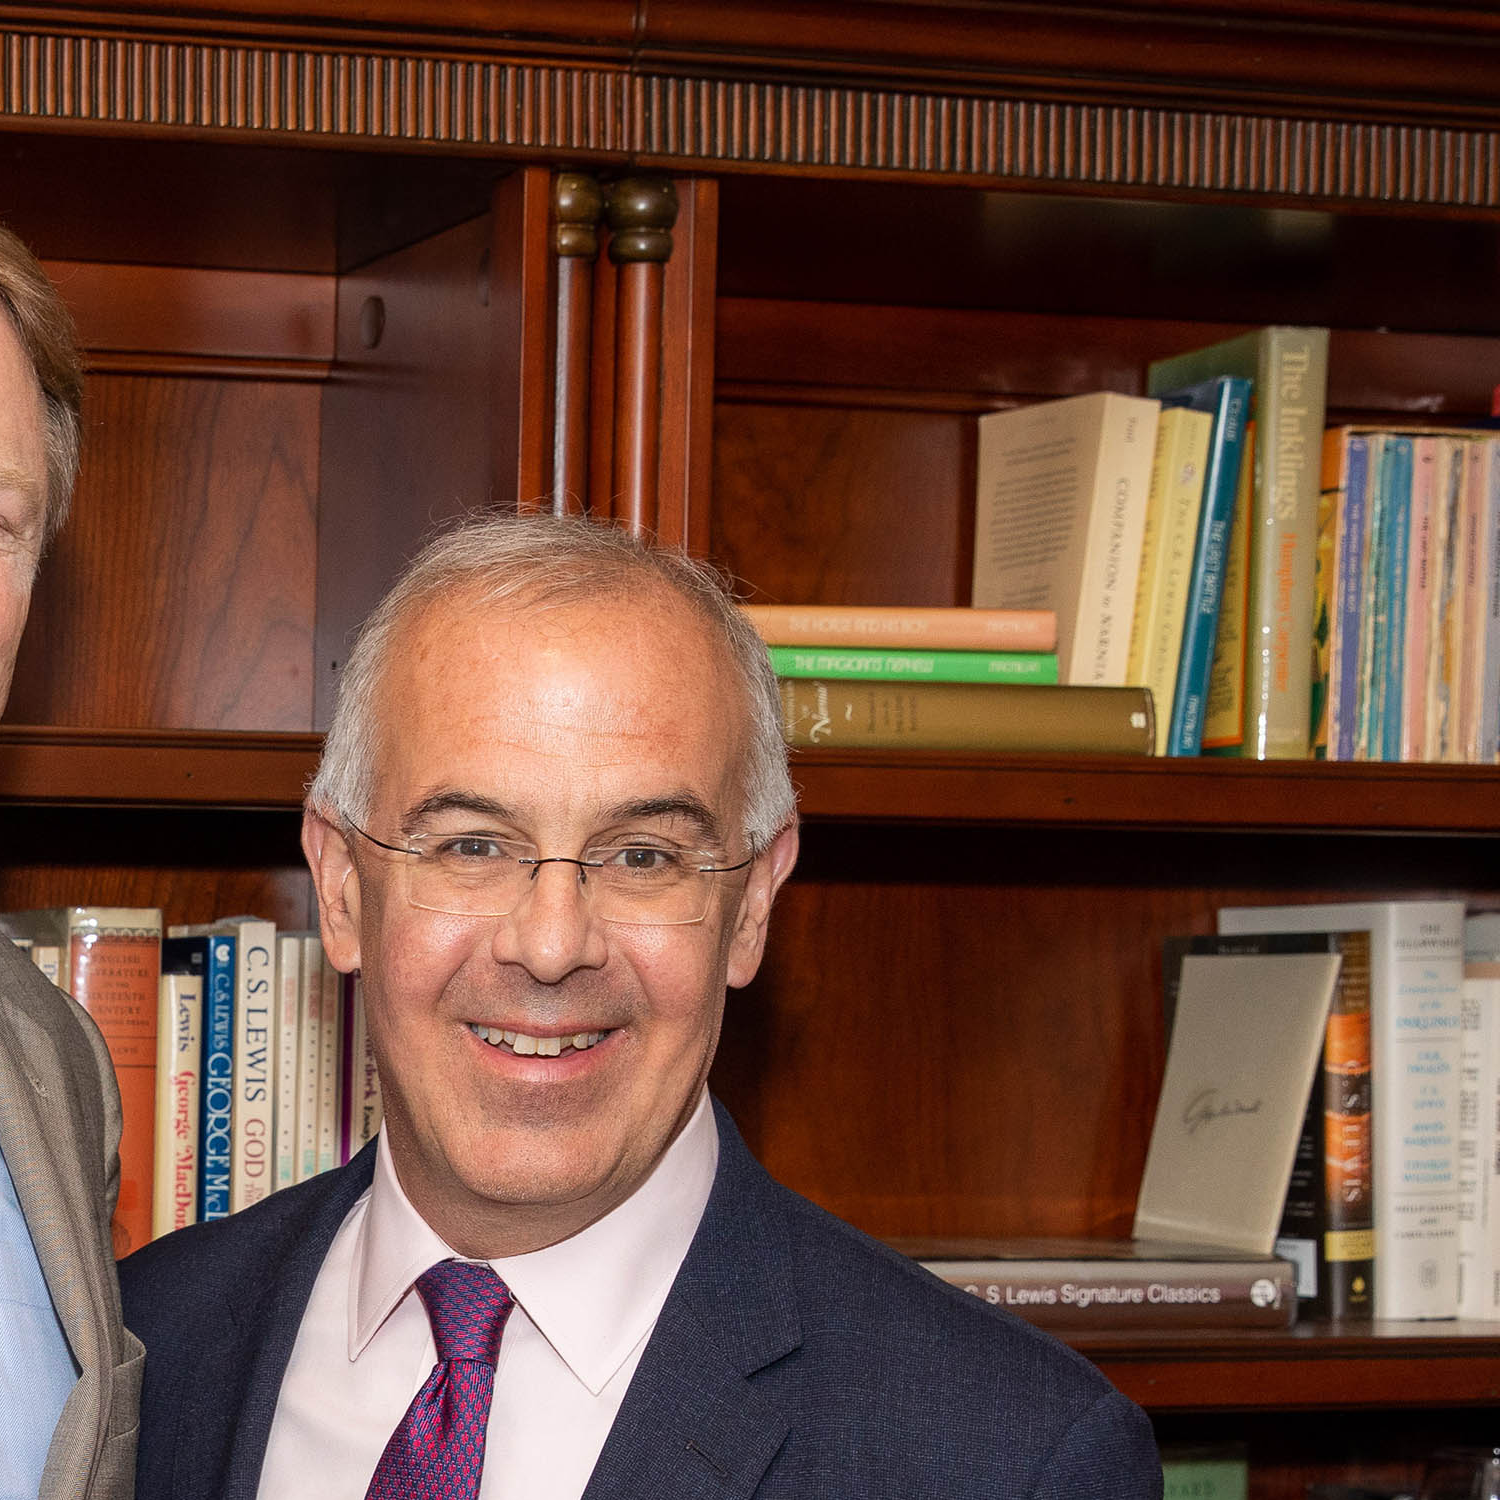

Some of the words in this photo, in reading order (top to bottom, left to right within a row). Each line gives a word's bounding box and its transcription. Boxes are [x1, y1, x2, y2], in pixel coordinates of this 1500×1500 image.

[1281, 344, 1310, 399] The
[1276, 406, 1309, 519] Inklings
[247, 945, 270, 972] C.
[247, 978, 269, 1000] S.
[178, 993, 197, 1052] Lewis
[213, 1004, 230, 1050] LEWIS
[244, 1007, 269, 1102] LEWIS
[171, 1070, 197, 1140] George
[206, 1052, 232, 1168] GEORGE
[243, 1117, 267, 1178] GOD
[1005, 1285, 1057, 1305] Lewis
[1060, 1285, 1144, 1308] Signature
[1147, 1284, 1221, 1304] Classics
